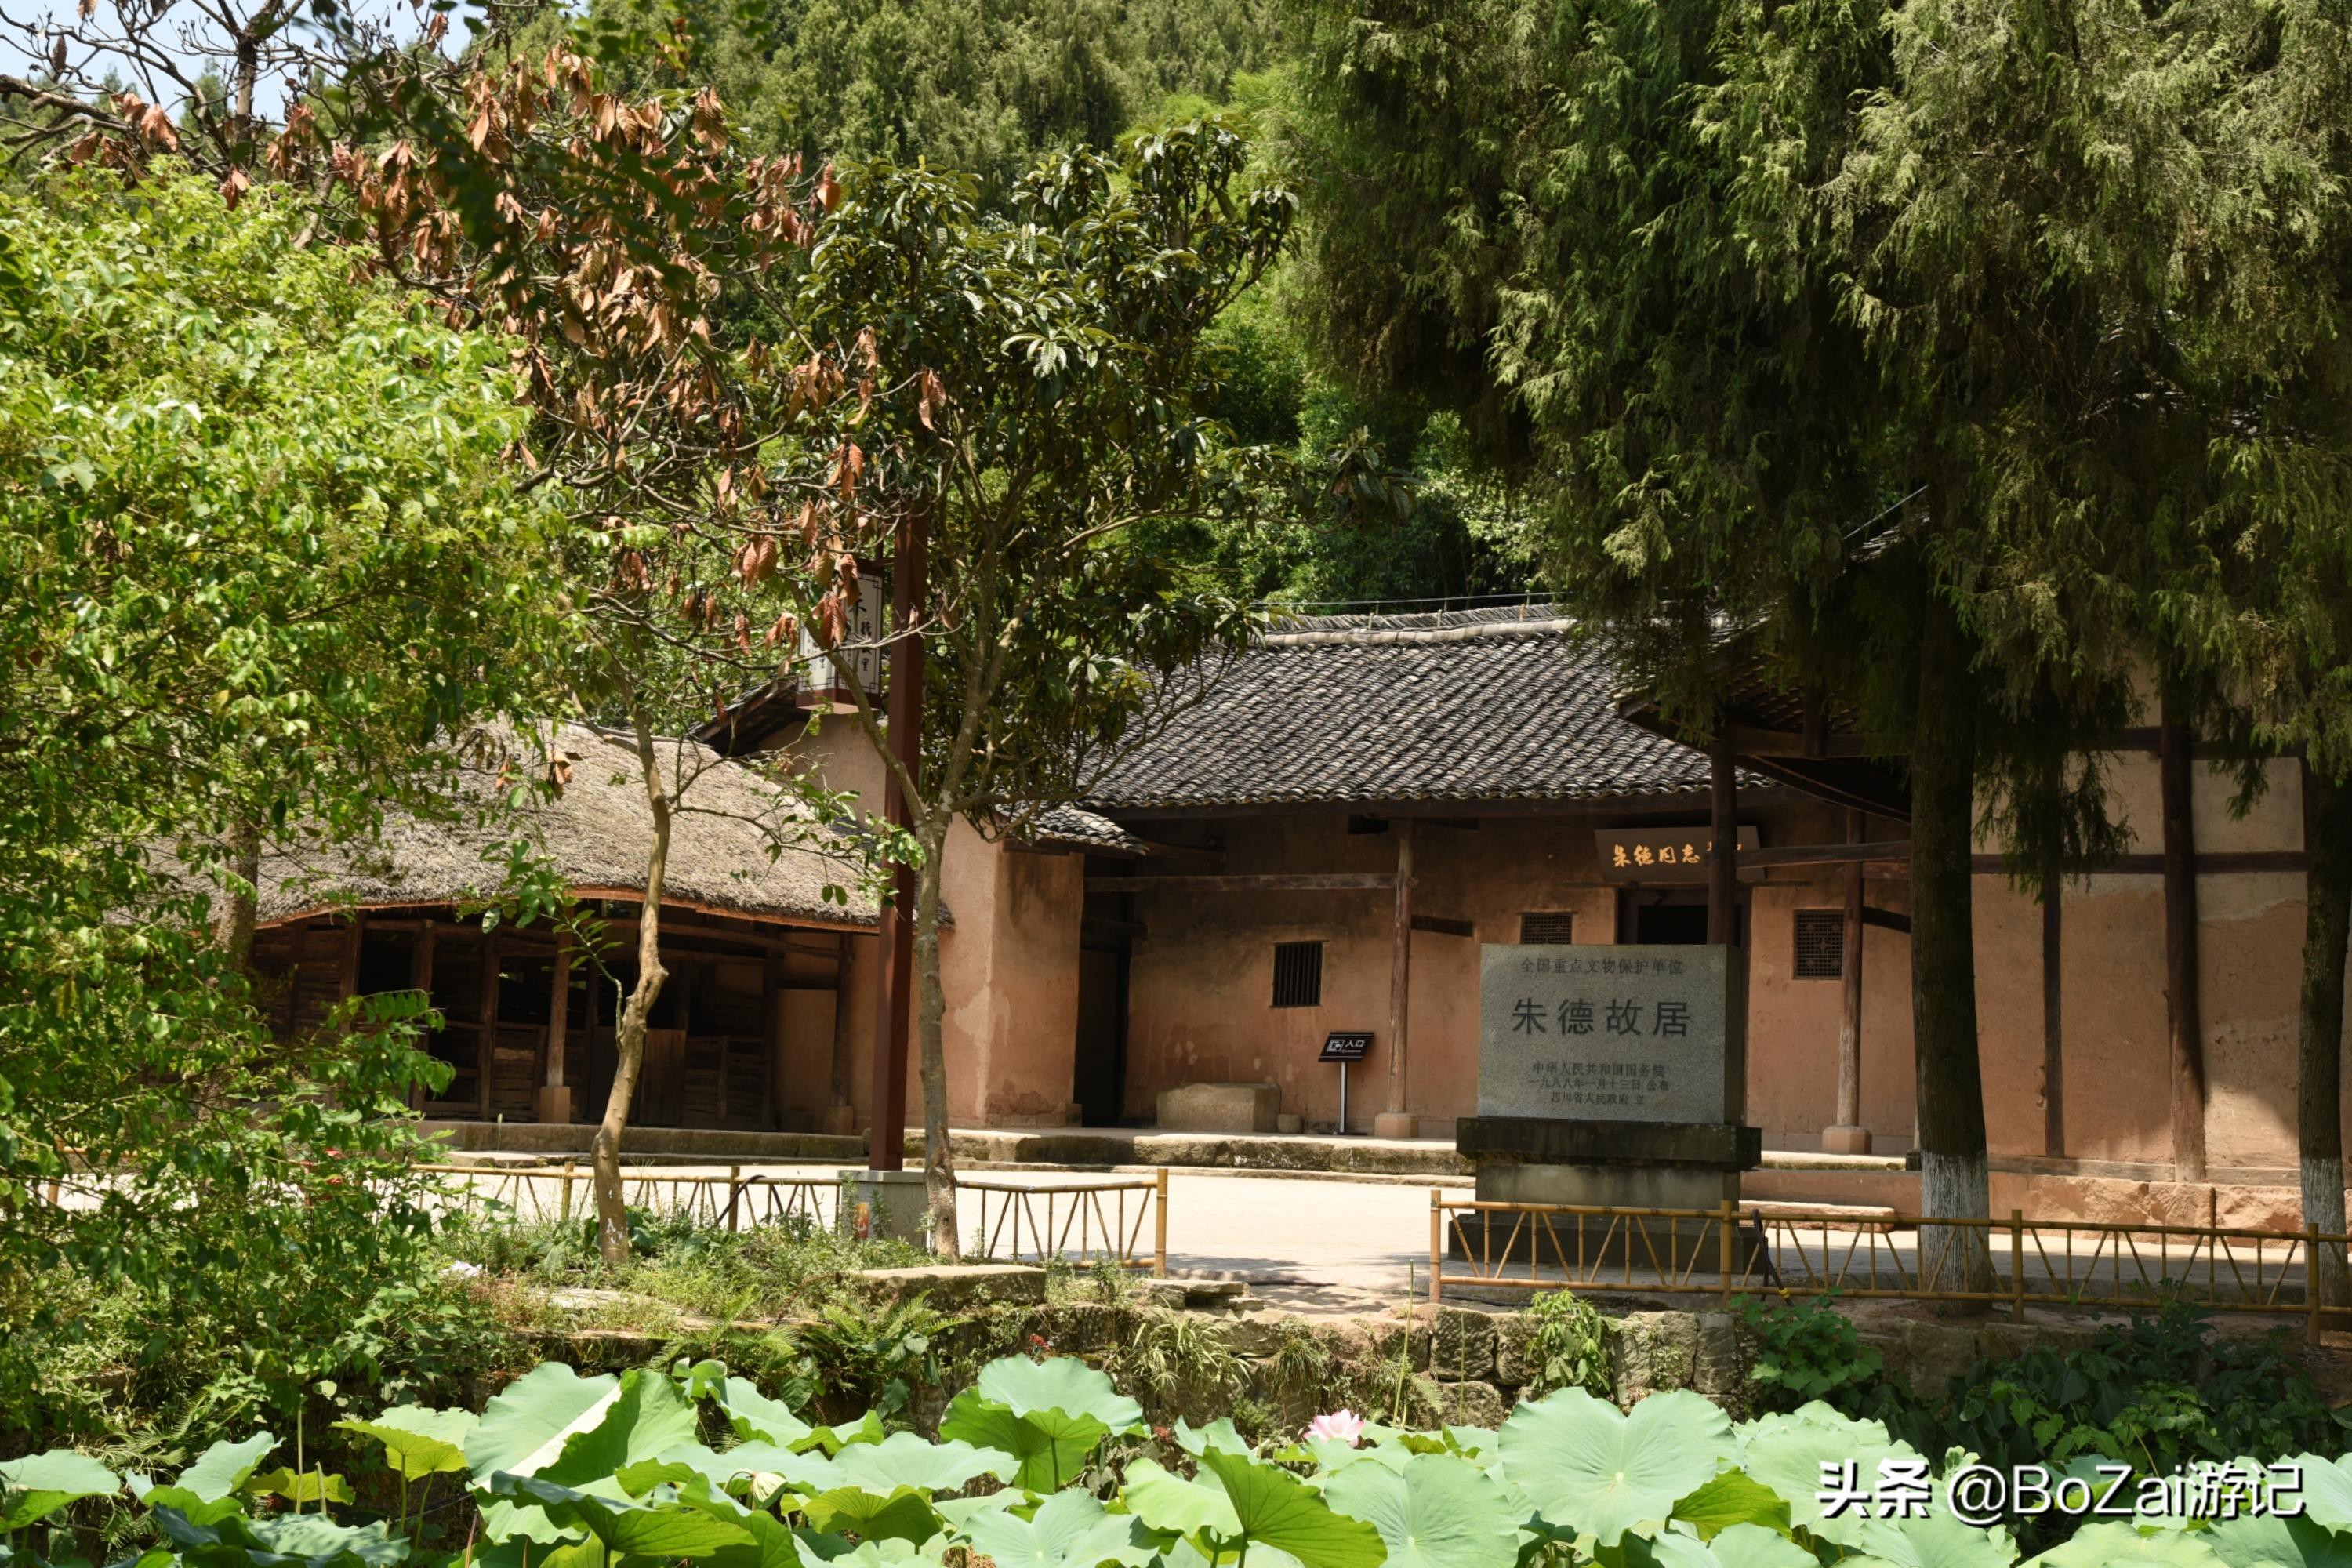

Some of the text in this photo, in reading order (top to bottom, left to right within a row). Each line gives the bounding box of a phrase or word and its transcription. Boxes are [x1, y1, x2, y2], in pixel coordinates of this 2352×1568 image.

[1613, 841, 1742, 867] 朱德同志
[1521, 957, 1683, 975] 全国重点文物保护单位
[1512, 998, 1691, 1037] 朱德故居
[1533, 1061, 1666, 1077] 中华人民共和国国务院
[1551, 1091, 1628, 1105] 四川省人民政府
